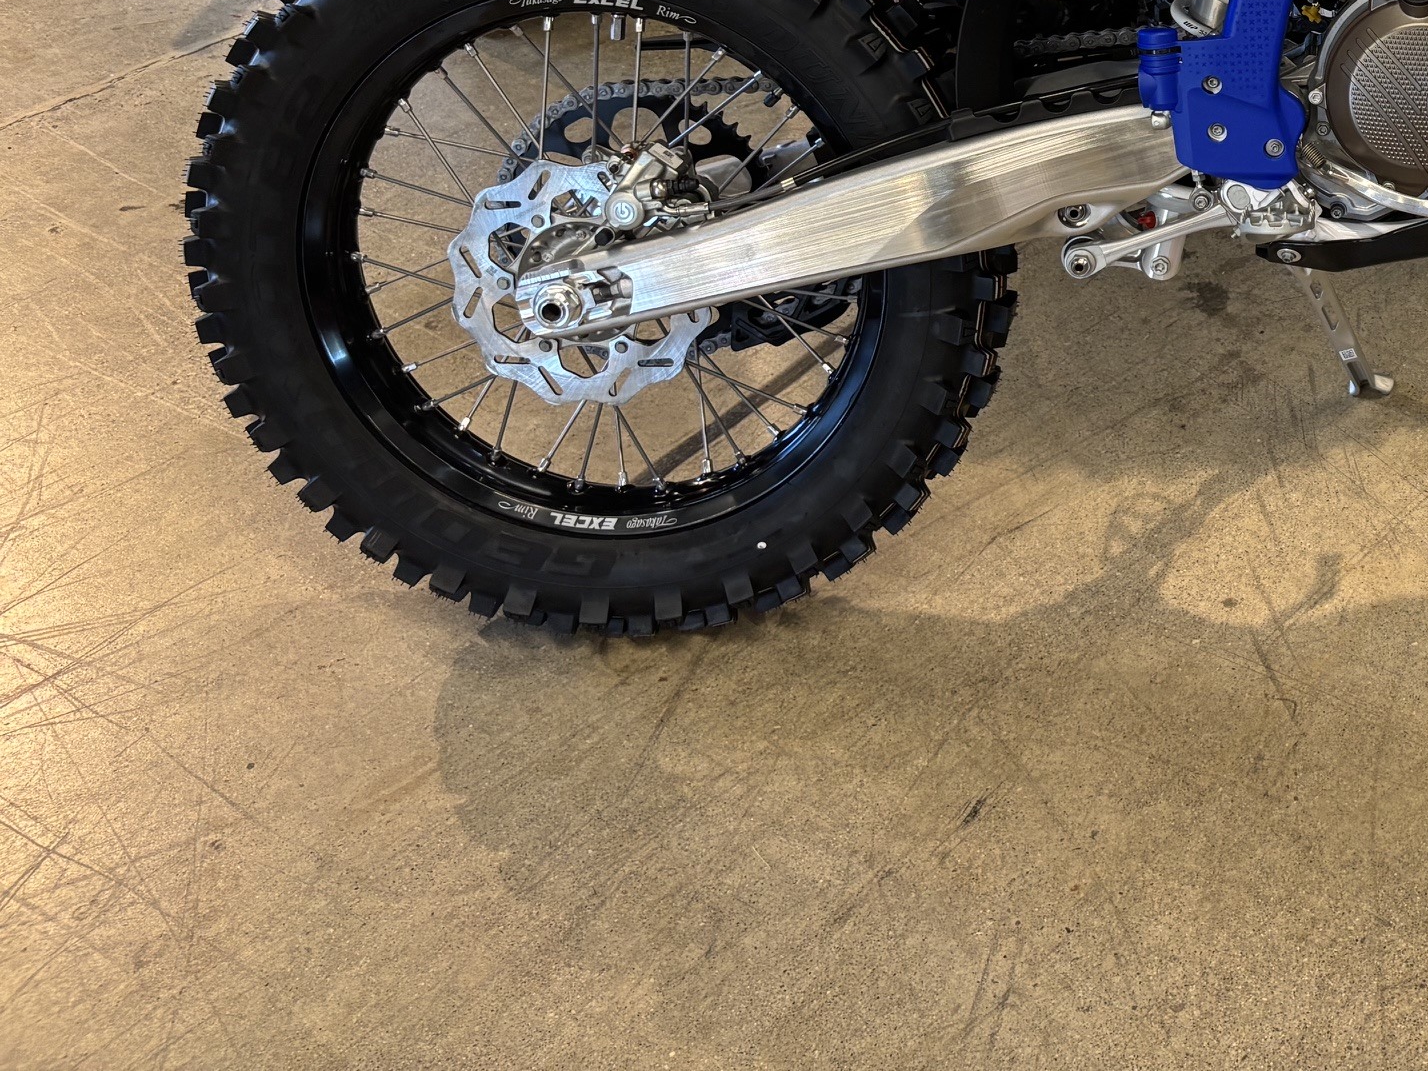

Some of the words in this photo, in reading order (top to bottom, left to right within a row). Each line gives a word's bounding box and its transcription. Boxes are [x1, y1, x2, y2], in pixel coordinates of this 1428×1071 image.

[656, 5, 696, 25] Rim
[498, 501, 539, 520] Rim
[550, 512, 619, 530] EXCEL
[626, 514, 678, 529] Takasago
